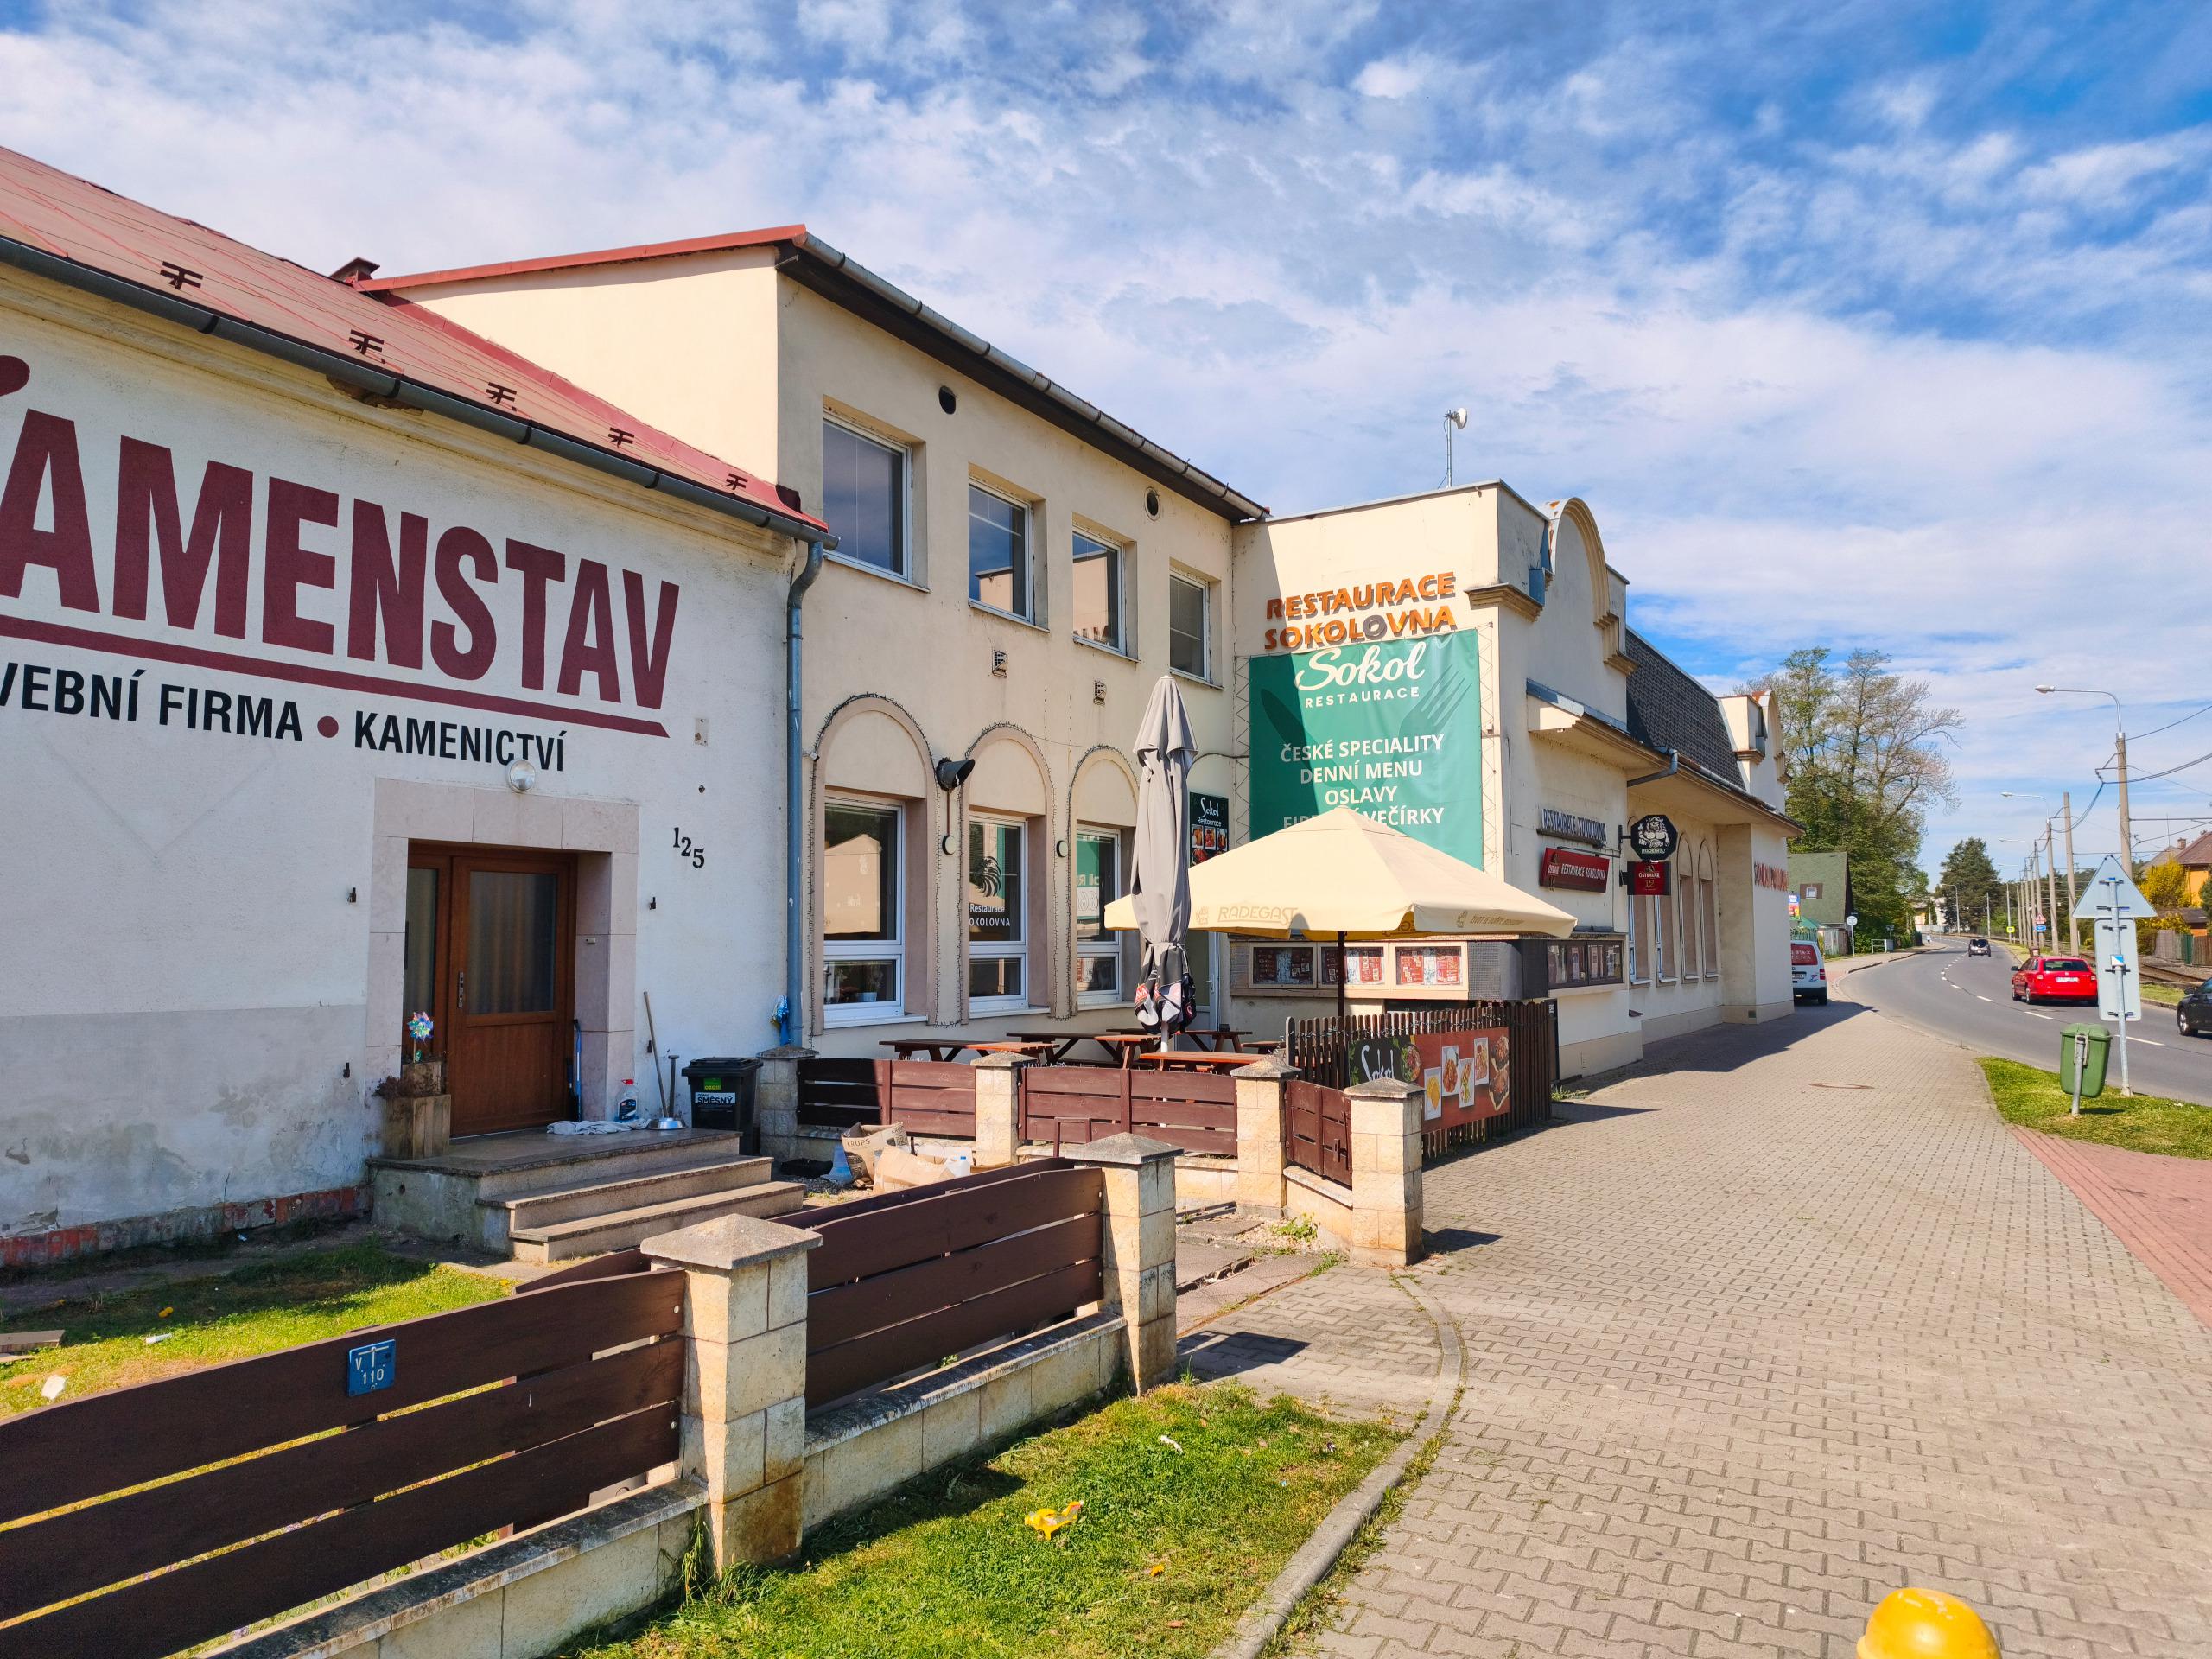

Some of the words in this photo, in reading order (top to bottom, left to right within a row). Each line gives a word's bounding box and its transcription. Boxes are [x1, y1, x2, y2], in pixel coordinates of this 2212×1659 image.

[1266, 571, 1455, 620] RESTAURACE
[1264, 605, 1457, 650] SOKOLOVNA
[1294, 641, 1427, 691] Sokol
[1305, 686, 1420, 709] RESTAURACE
[158, 683, 302, 744] FIRMA
[354, 709, 568, 772] KAMENICTVÍ
[1281, 738, 1334, 763] ČESKÉ
[1339, 733, 1445, 758] SPECIALITY
[1300, 760, 1360, 785] DENNÍ
[1365, 760, 1423, 779] MENU
[1325, 785, 1398, 805] OSLAVY
[1363, 805, 1445, 826] VEČÍRKY
[672, 826, 705, 869] 125
[969, 903, 1005, 914] Restaurace
[1217, 906, 1299, 926] RADEGAST
[1361, 1044, 1395, 1082] Sokol
[697, 1095, 734, 1105] SMĚSNÝ
[847, 1138, 871, 1147] KRUPS
